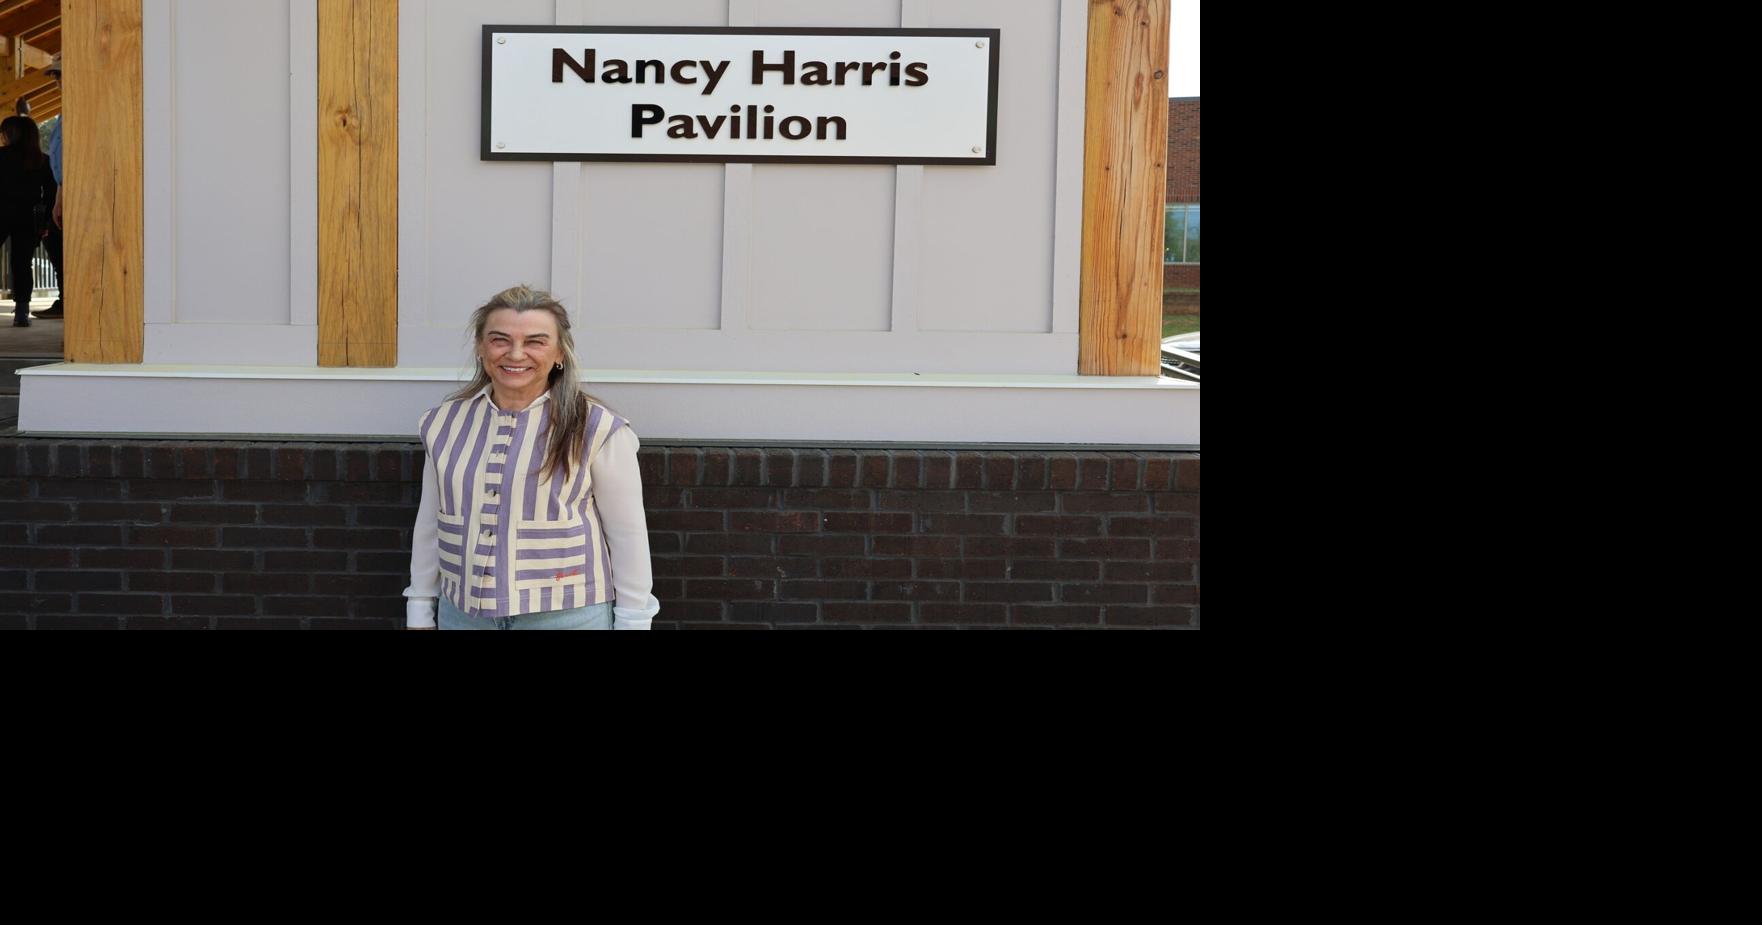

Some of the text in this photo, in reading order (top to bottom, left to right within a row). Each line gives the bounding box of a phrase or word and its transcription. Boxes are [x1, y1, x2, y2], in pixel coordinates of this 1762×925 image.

[551, 47, 929, 96] Nancy Harris
[631, 103, 847, 141] Pavilion
